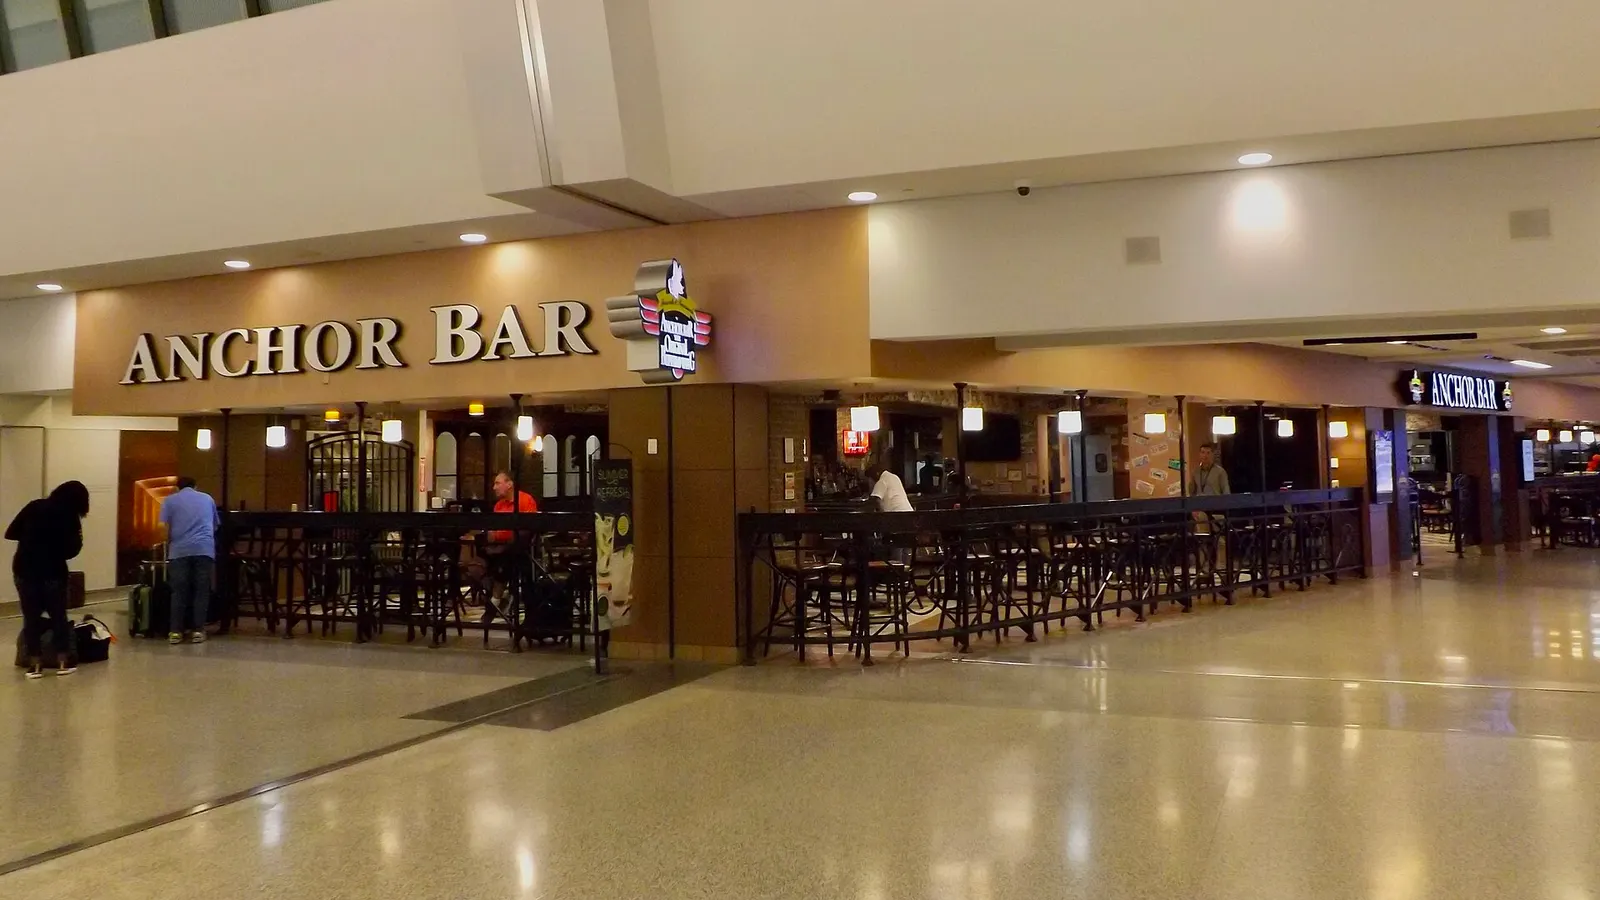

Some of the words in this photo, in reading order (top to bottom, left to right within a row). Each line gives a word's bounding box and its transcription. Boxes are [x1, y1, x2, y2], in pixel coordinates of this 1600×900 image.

[119, 317, 409, 385] ANCHOR
[429, 301, 597, 366] BAR
[1432, 372, 1477, 408] ANCHOR
[1476, 377, 1498, 410] BAR
